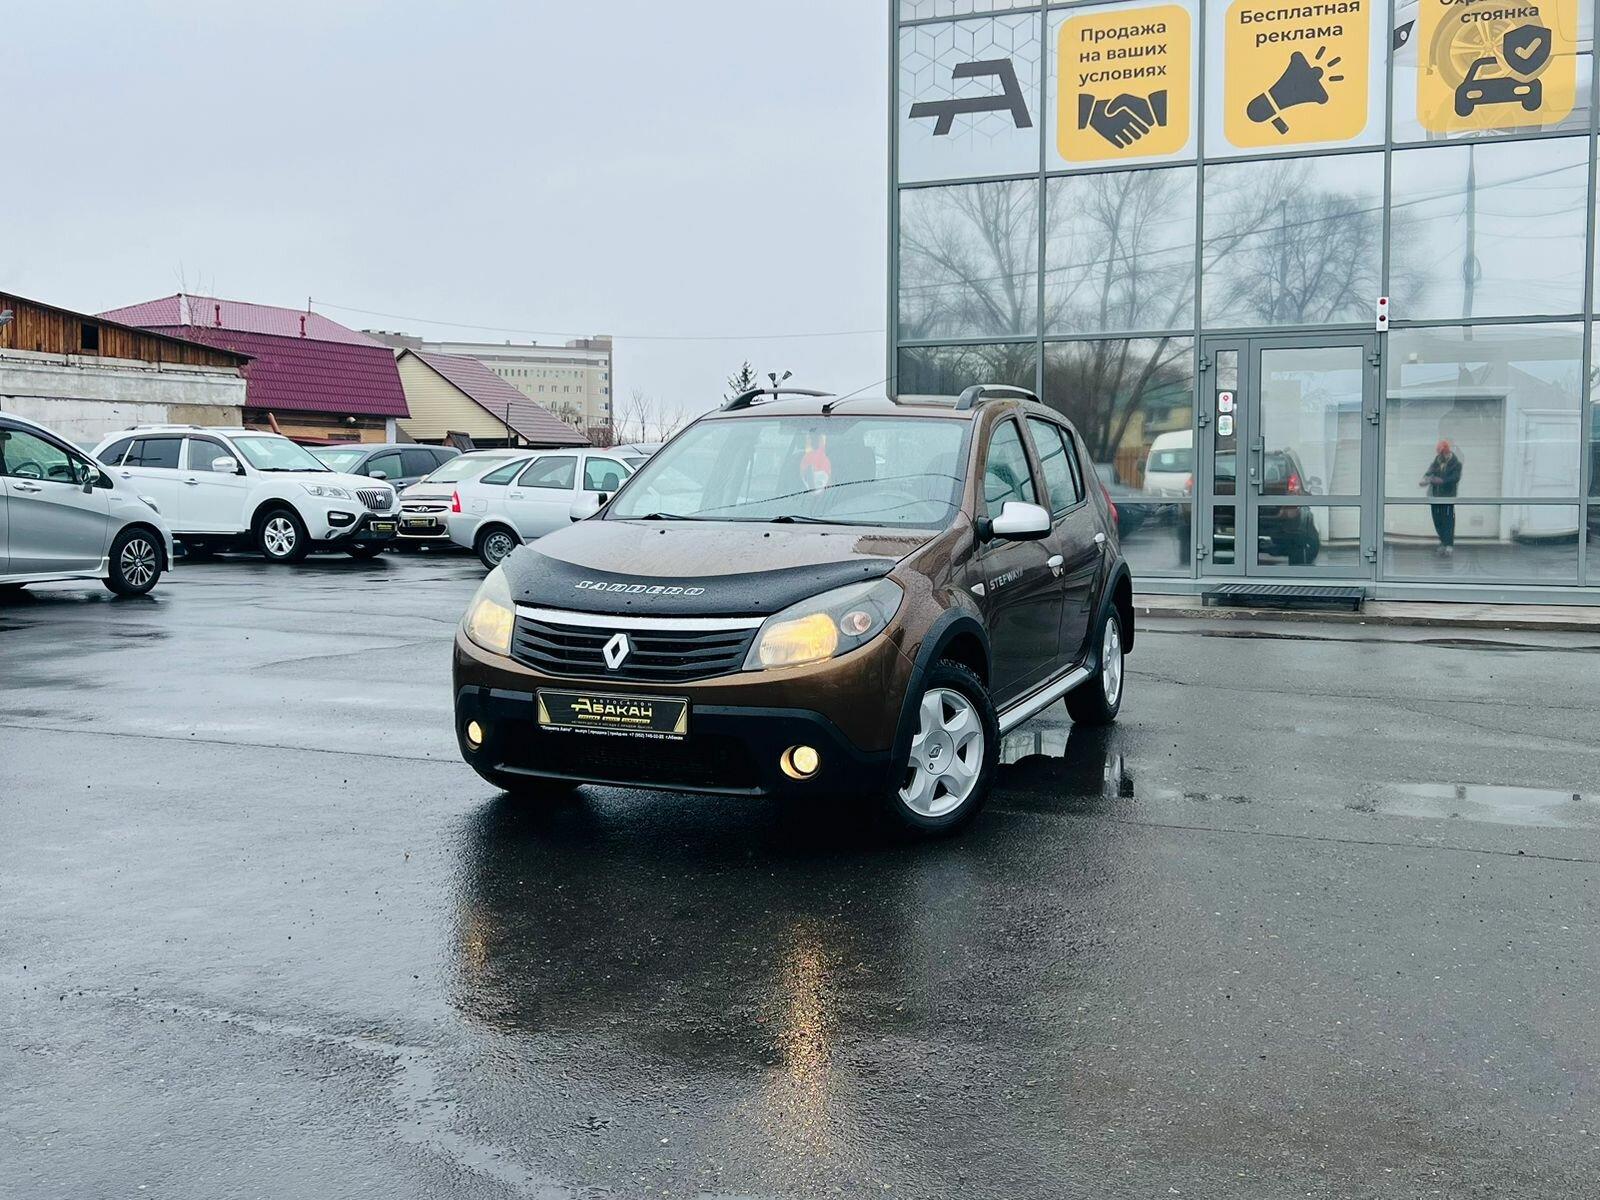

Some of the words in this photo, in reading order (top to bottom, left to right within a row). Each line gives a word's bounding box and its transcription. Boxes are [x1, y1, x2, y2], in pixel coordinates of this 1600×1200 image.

[1240, 1, 1360, 24] Бесплатная
[1461, 7, 1539, 23] стоянка
[1081, 23, 1166, 43] Продажа
[1256, 25, 1343, 47] реклама
[1080, 51, 1100, 62] на
[1107, 44, 1167, 60] ваших
[1079, 65, 1167, 87] условиях
[575, 580, 705, 596] SANDERO
